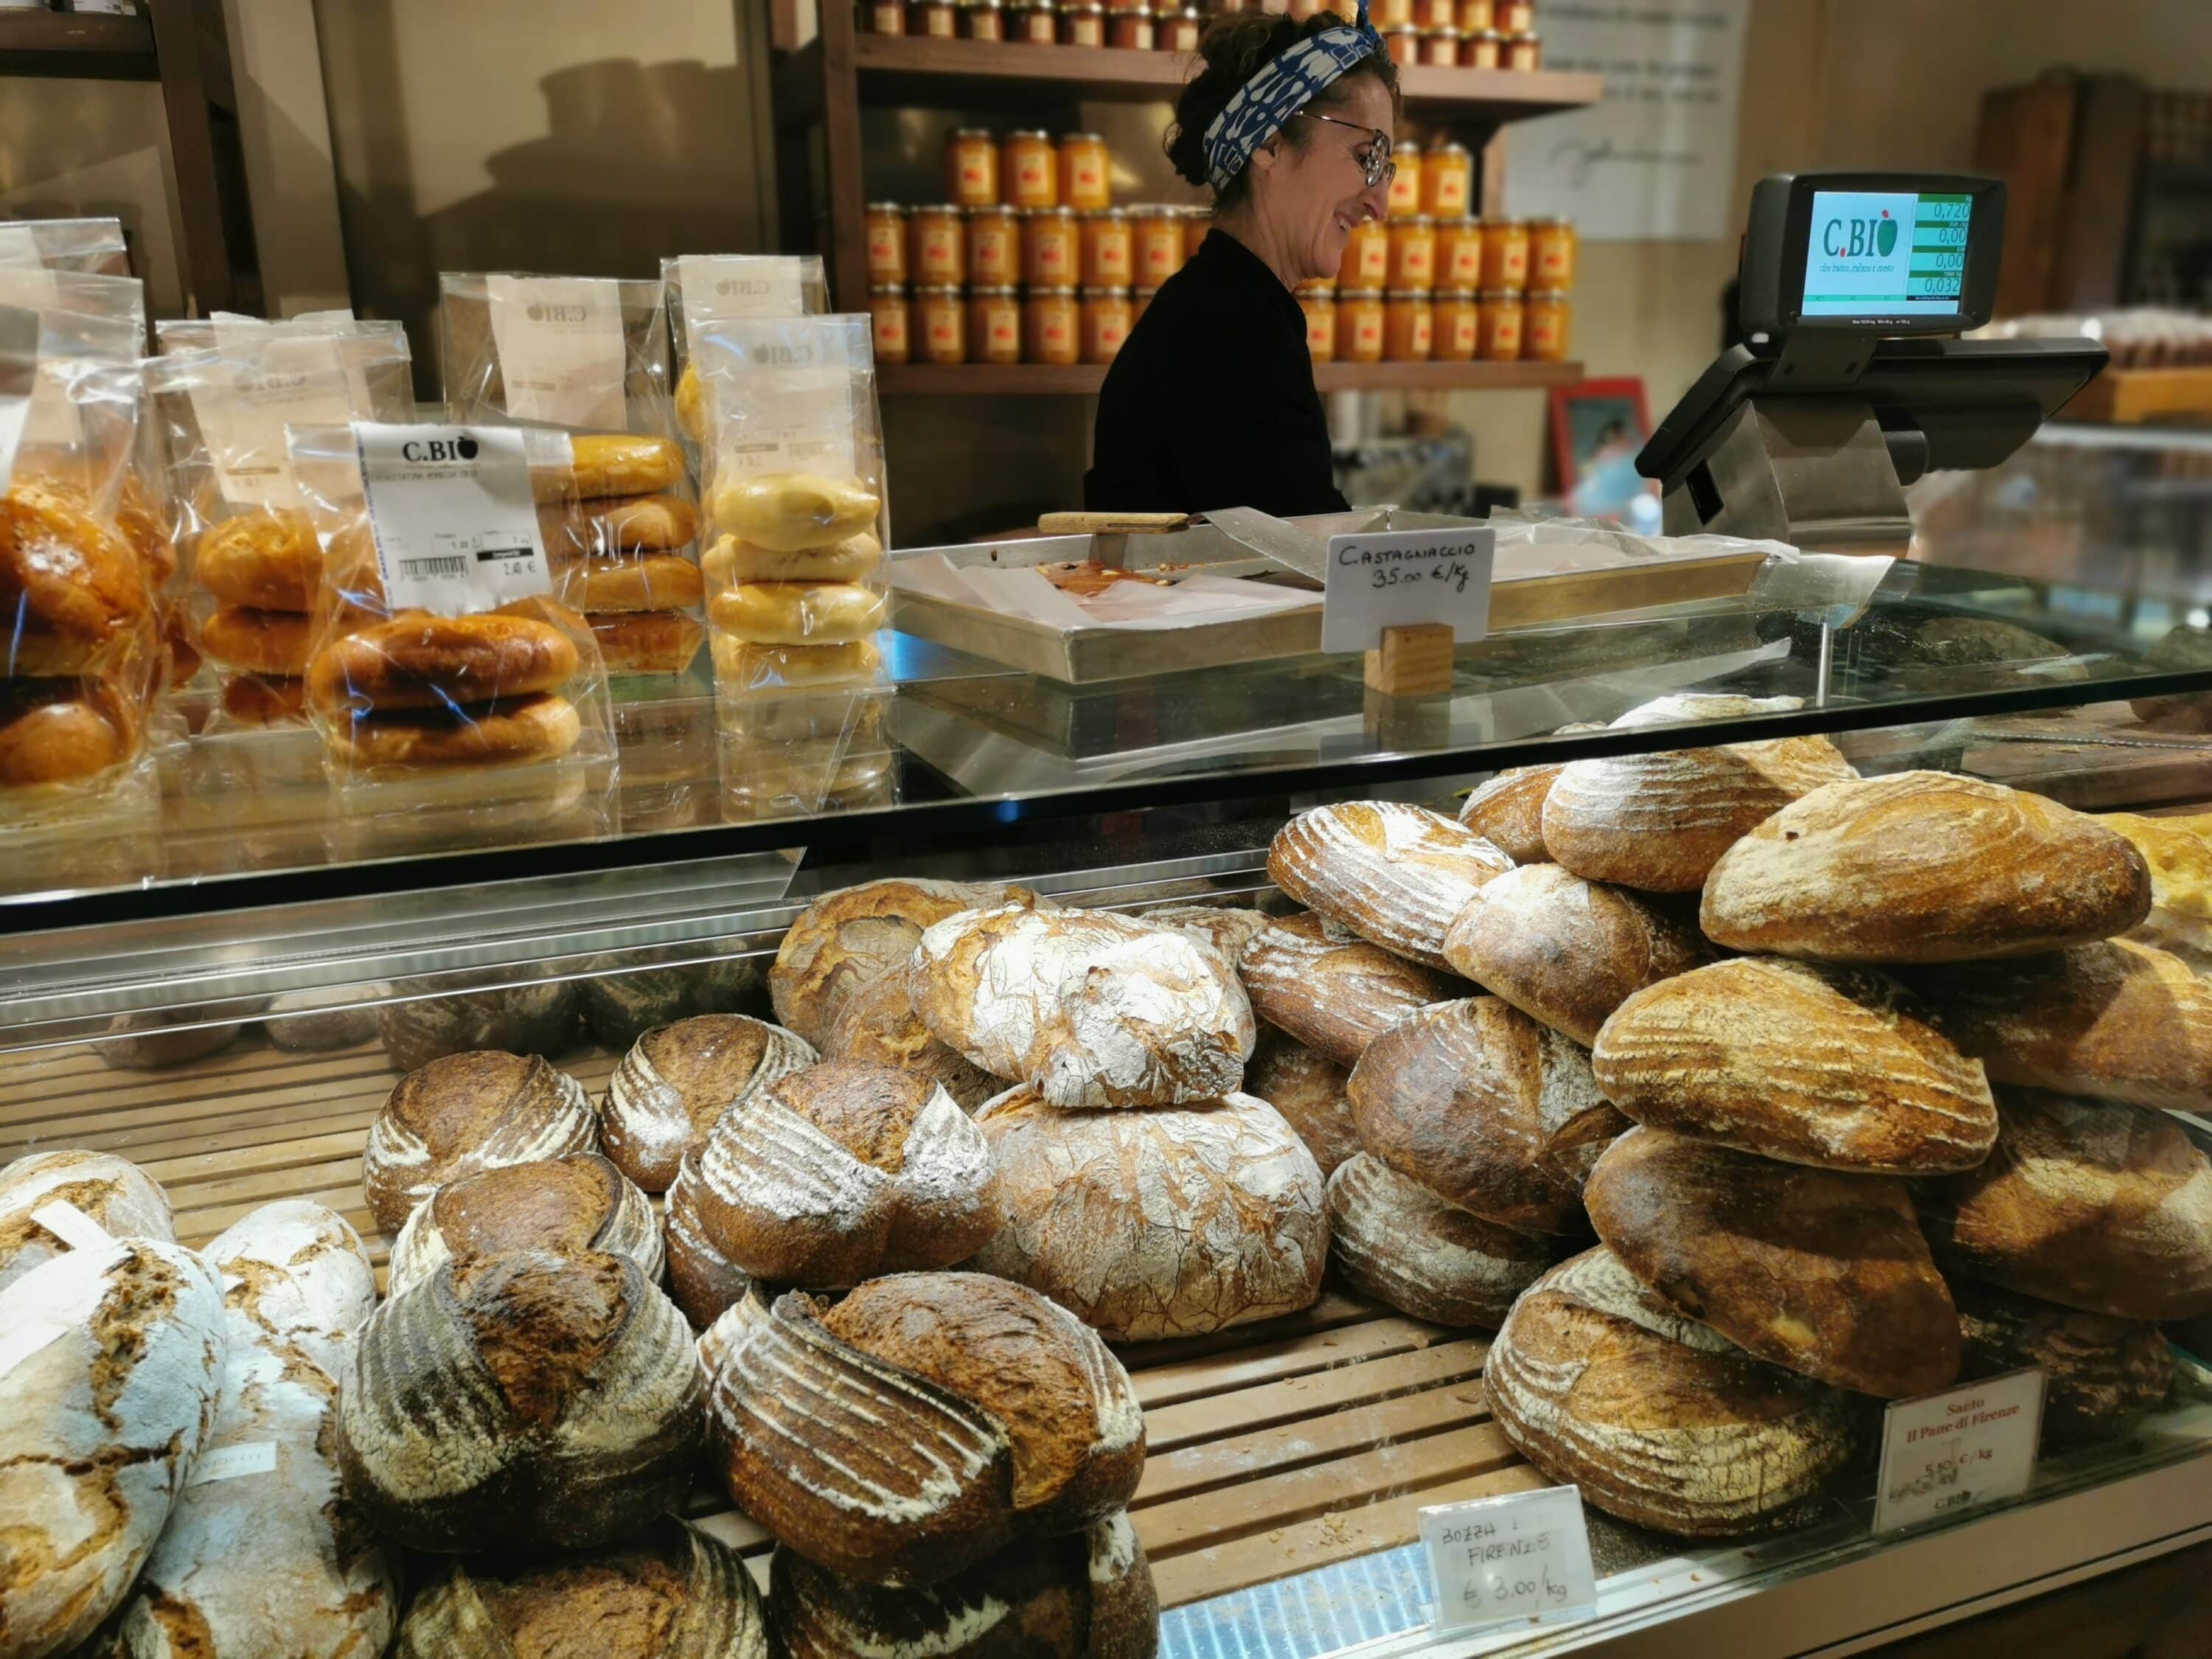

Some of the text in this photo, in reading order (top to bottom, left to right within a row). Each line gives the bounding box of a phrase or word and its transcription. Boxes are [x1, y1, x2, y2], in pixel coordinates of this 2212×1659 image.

[1934, 204, 1970, 219] 0,720
[1938, 229, 1966, 244] 0,00
[1935, 253, 1964, 269] 0,00
[1924, 278, 1960, 293] 0,032
[1338, 543, 1475, 566] CASTAGNACCIO
[1372, 567, 1422, 588] 35.00
[1906, 1405, 2020, 1444] Il Pane di Firenze
